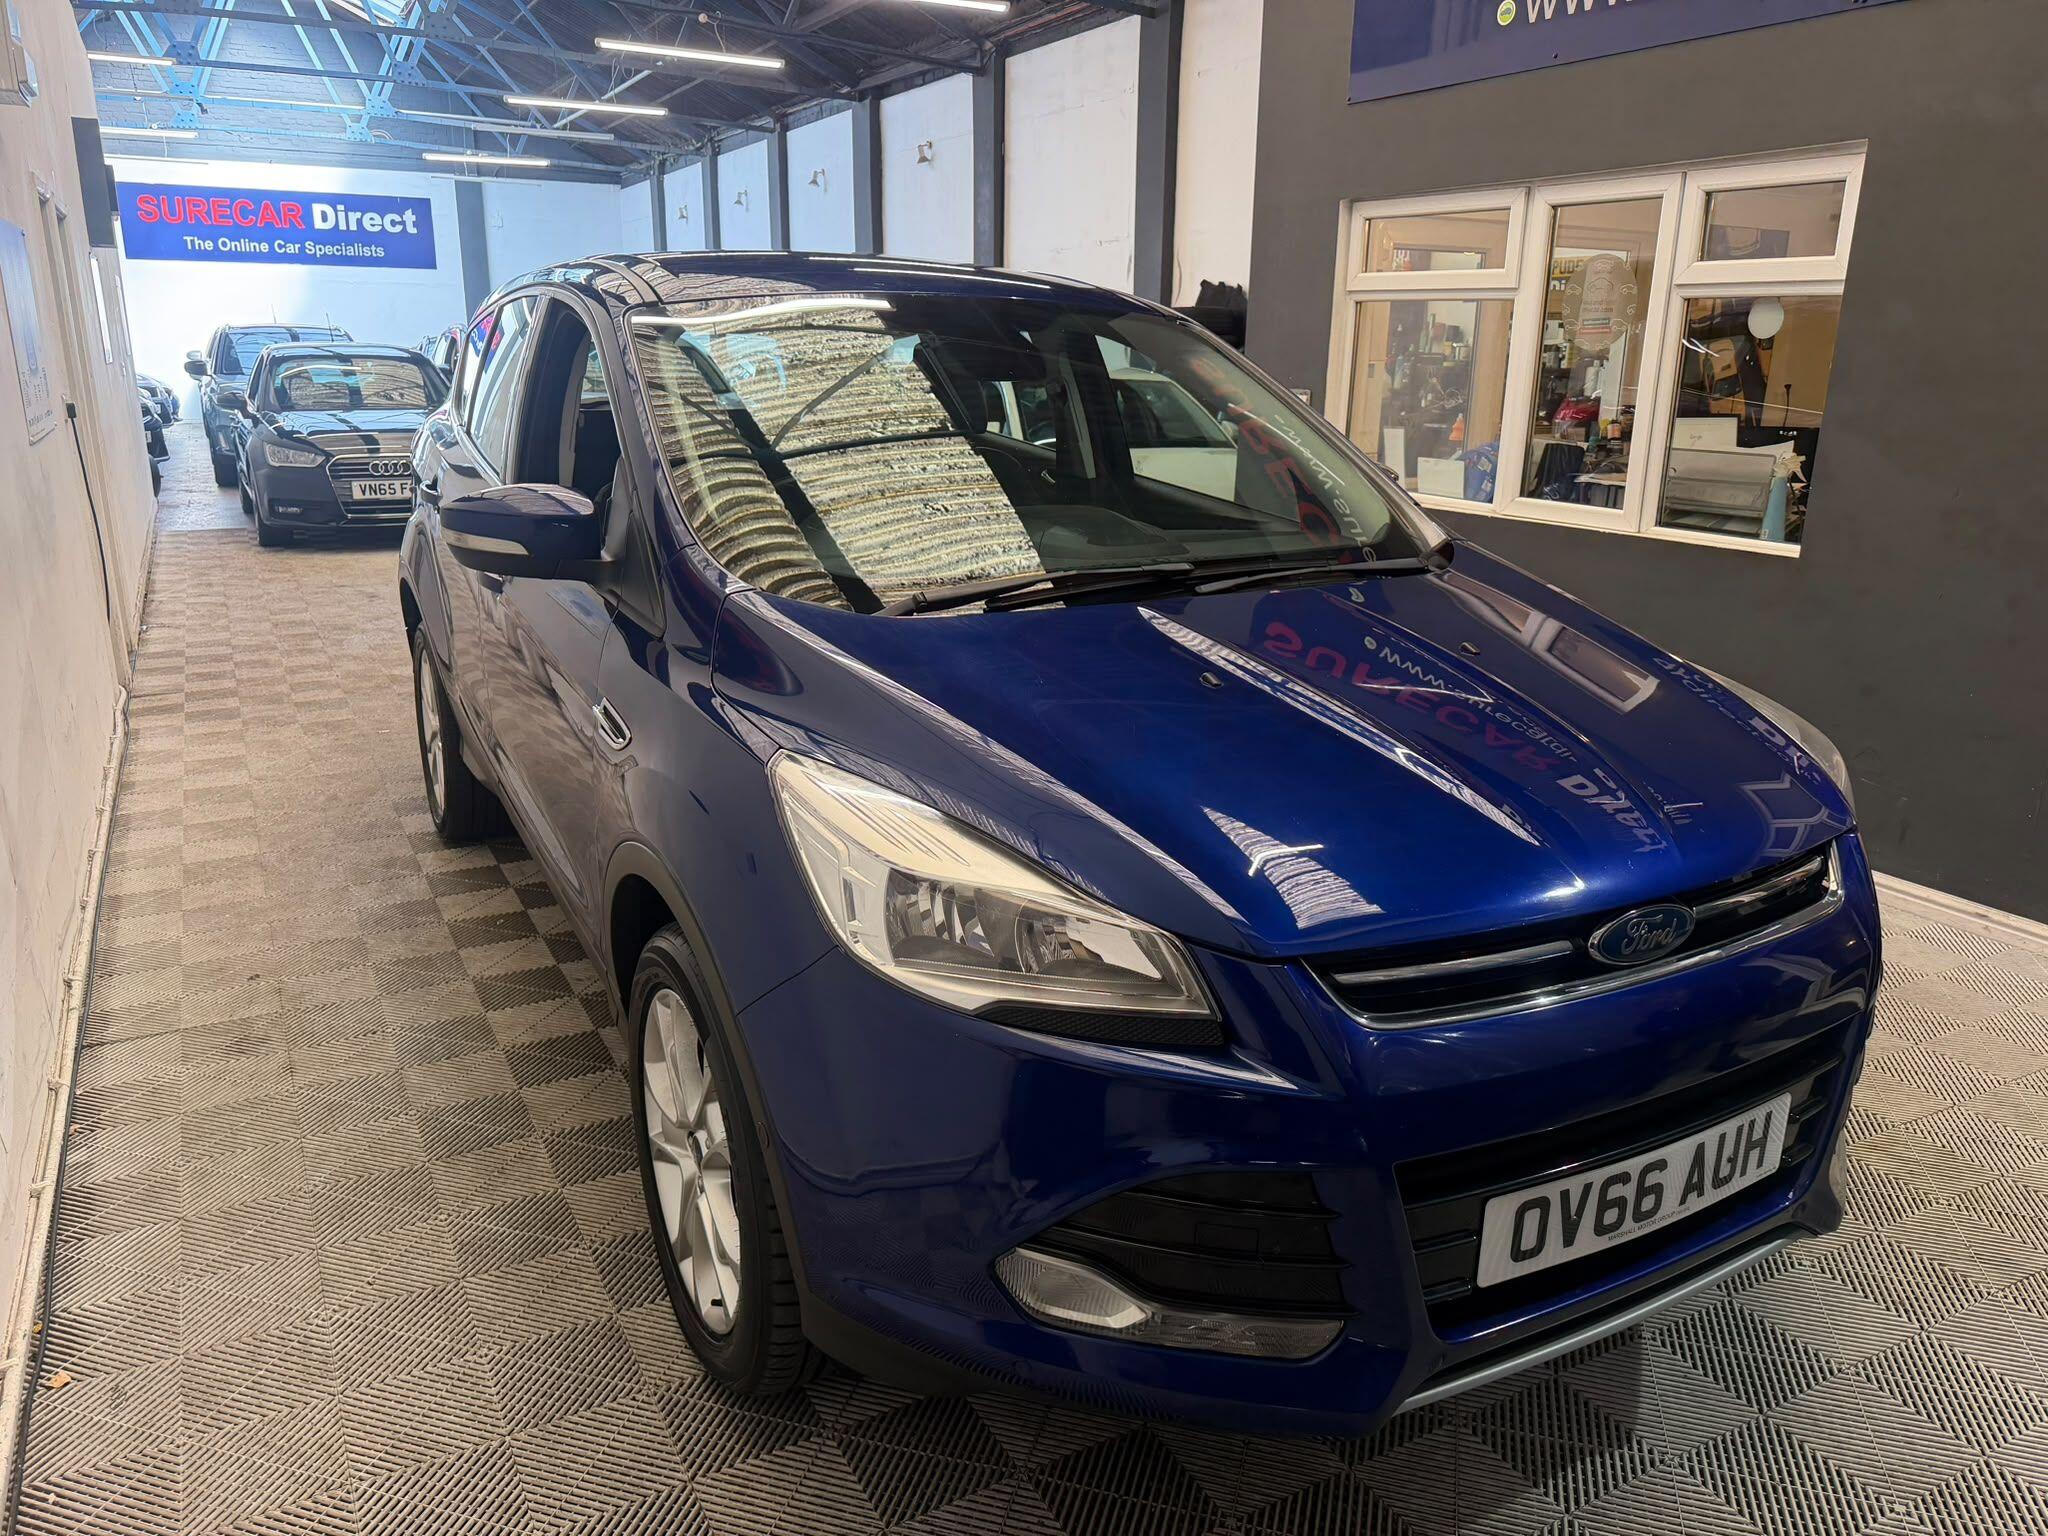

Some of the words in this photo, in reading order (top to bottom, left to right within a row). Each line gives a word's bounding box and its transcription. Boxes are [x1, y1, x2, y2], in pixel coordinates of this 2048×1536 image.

[136, 194, 305, 229] SURECAR
[312, 203, 418, 234] Direct
[183, 236, 214, 251] The
[218, 237, 269, 253] Online
[274, 239, 301, 255] Car
[305, 241, 385, 258] Specialists
[359, 482, 397, 497] VN65
[1621, 914, 1677, 955] Ford
[1510, 1158, 1669, 1263] OV66
[1679, 1110, 1773, 1207] AUH
